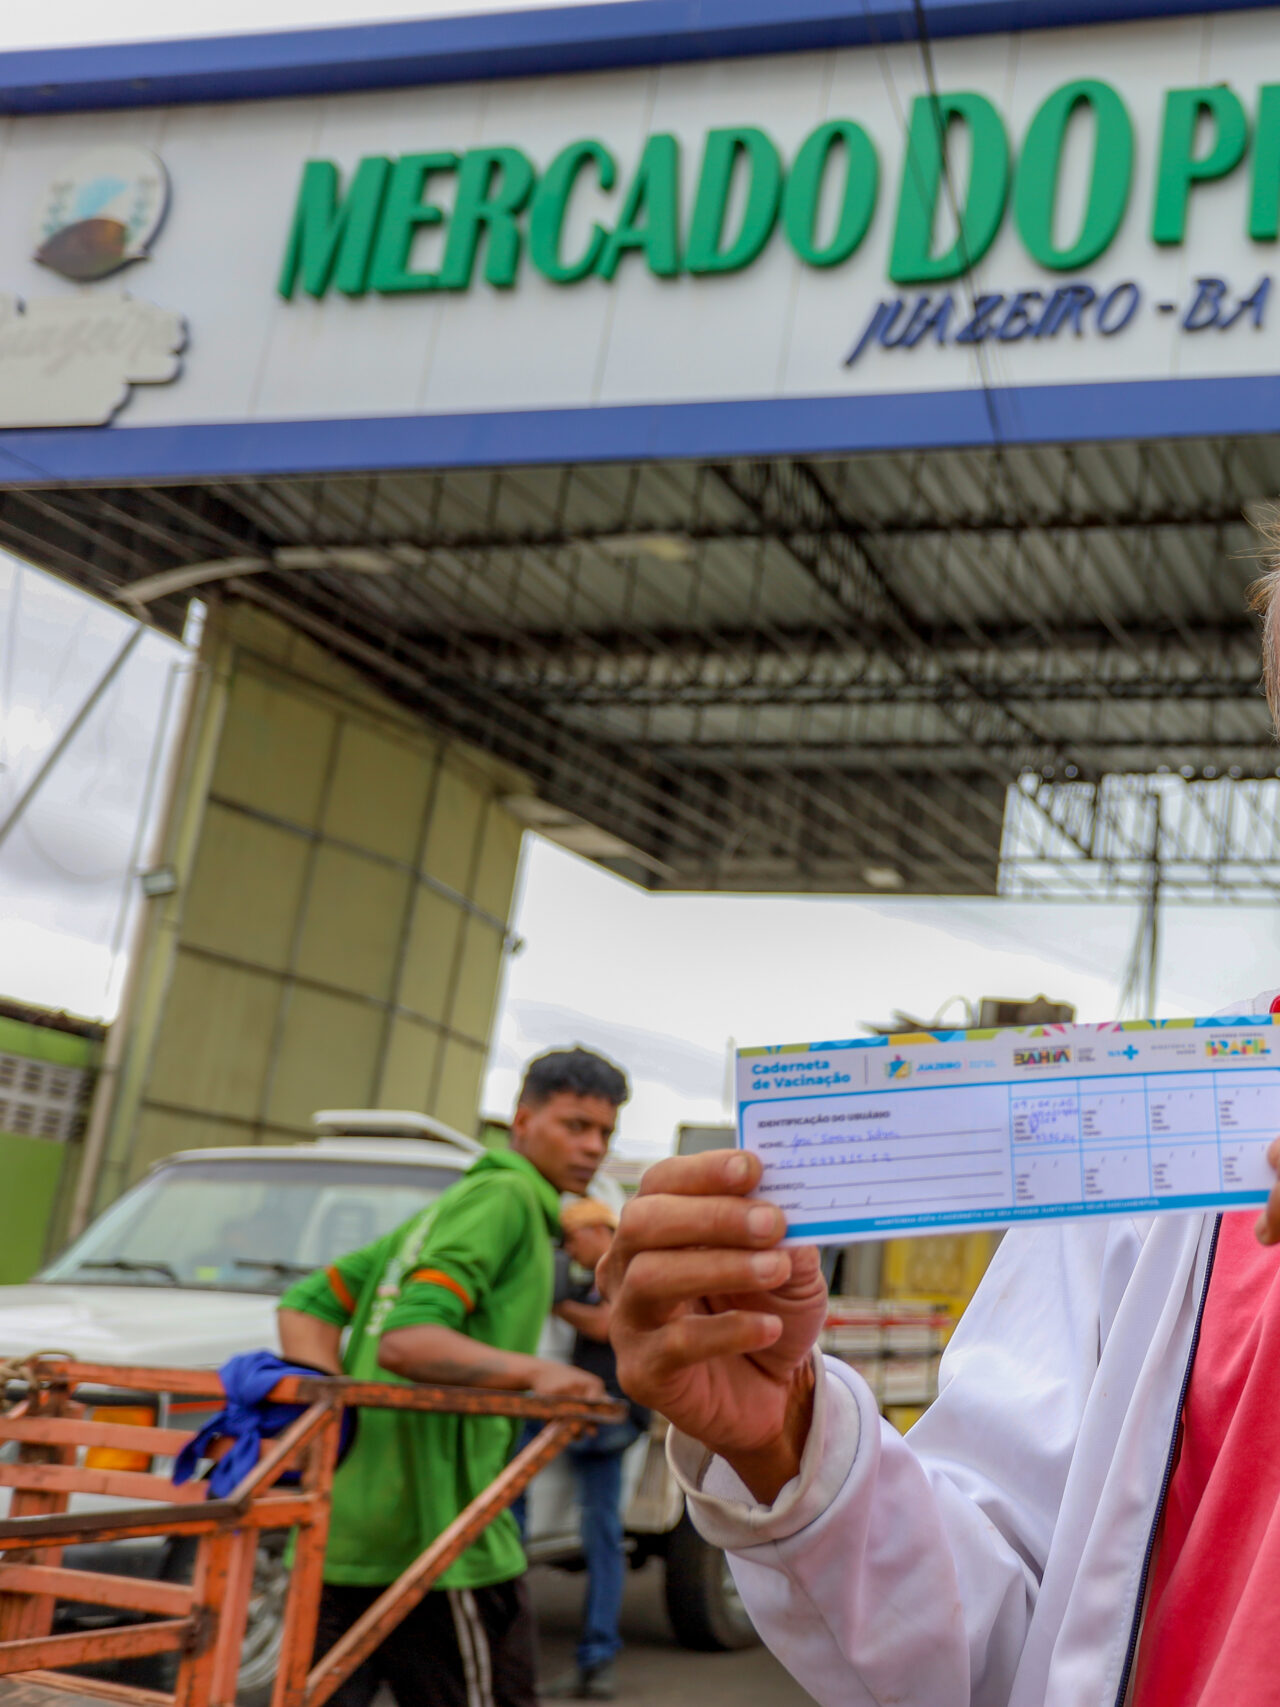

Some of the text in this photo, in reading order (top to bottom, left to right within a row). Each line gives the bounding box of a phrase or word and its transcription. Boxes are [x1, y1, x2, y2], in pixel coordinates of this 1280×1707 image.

[279, 119, 880, 300] MERCADO
[888, 79, 1134, 285] DO
[844, 279, 1141, 367] JUAZEIRO
[752, 1058, 830, 1076] Caderneta
[752, 1071, 852, 1091] de Vacinação
